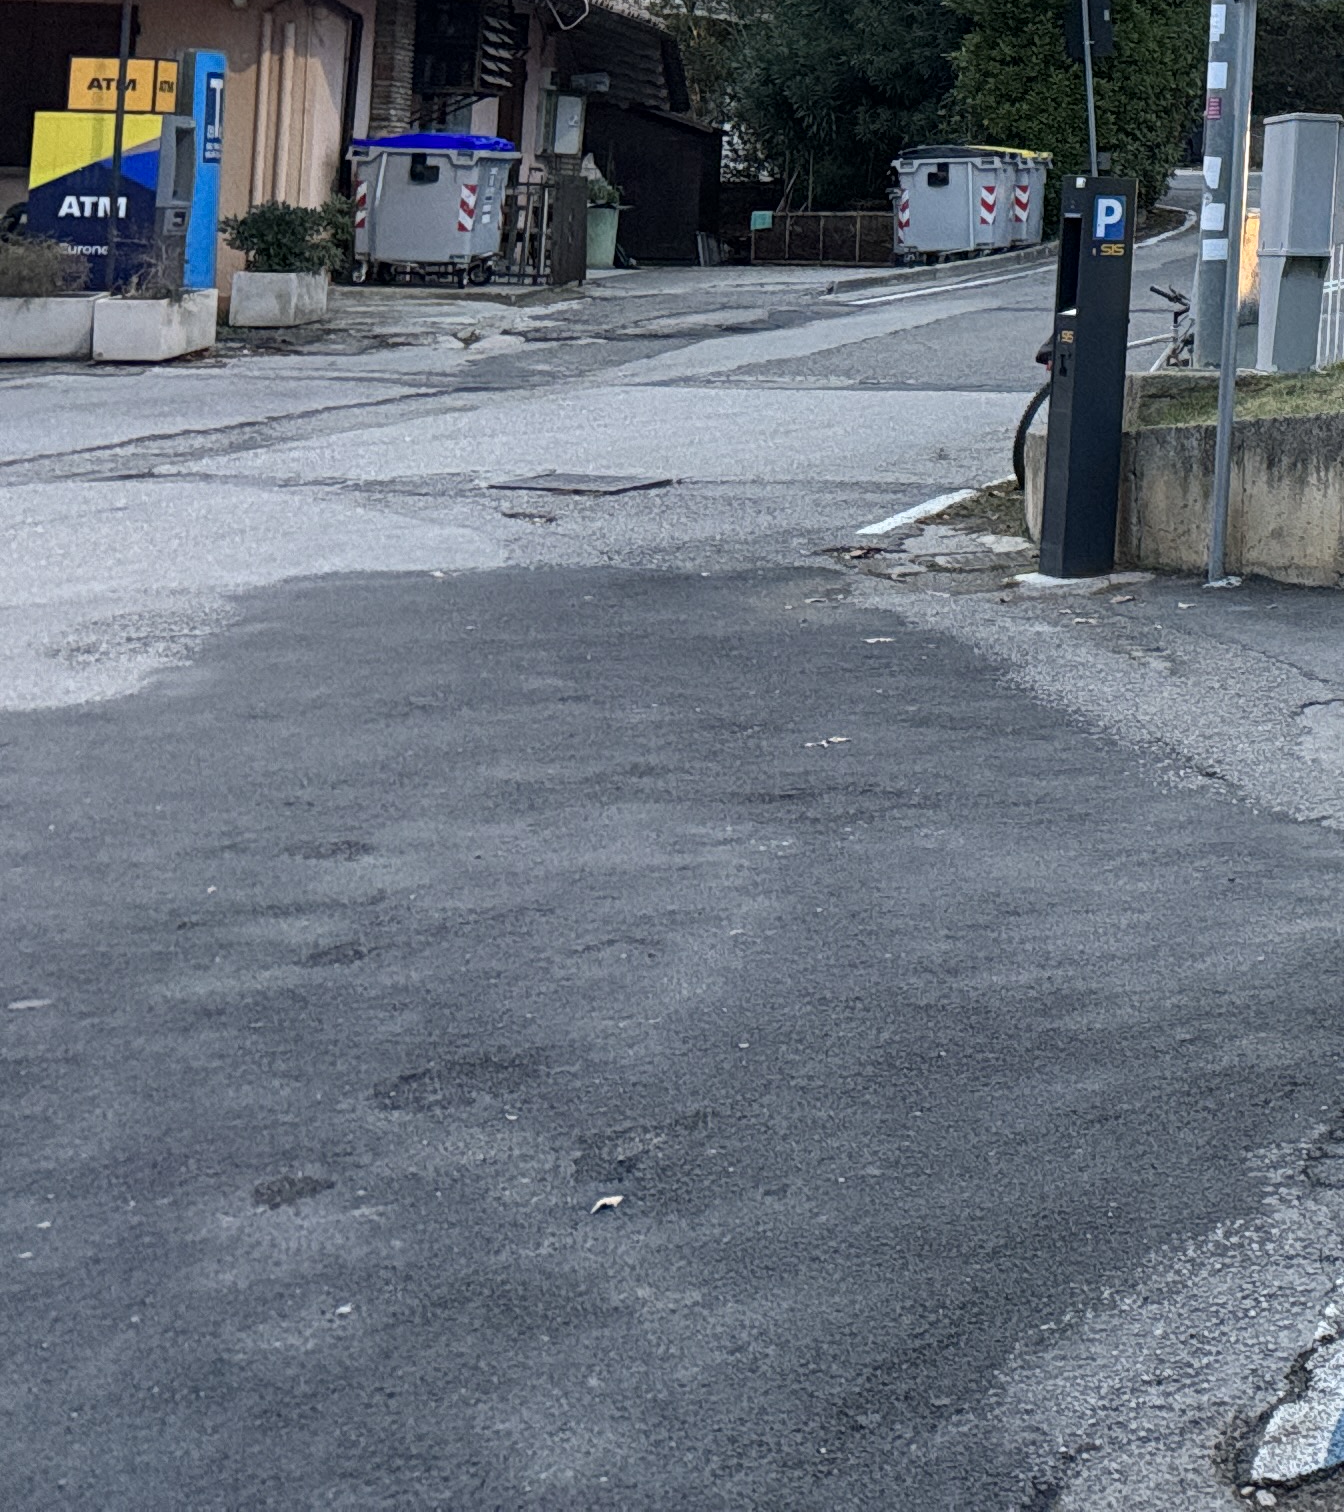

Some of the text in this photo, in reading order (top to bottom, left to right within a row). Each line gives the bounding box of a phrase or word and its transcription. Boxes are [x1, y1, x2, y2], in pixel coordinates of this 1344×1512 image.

[87, 77, 137, 92] ATM
[57, 195, 128, 219] ATM
[1095, 198, 1123, 238] P
[60, 242, 109, 256] Eurone
[1100, 243, 1125, 256] SIS
